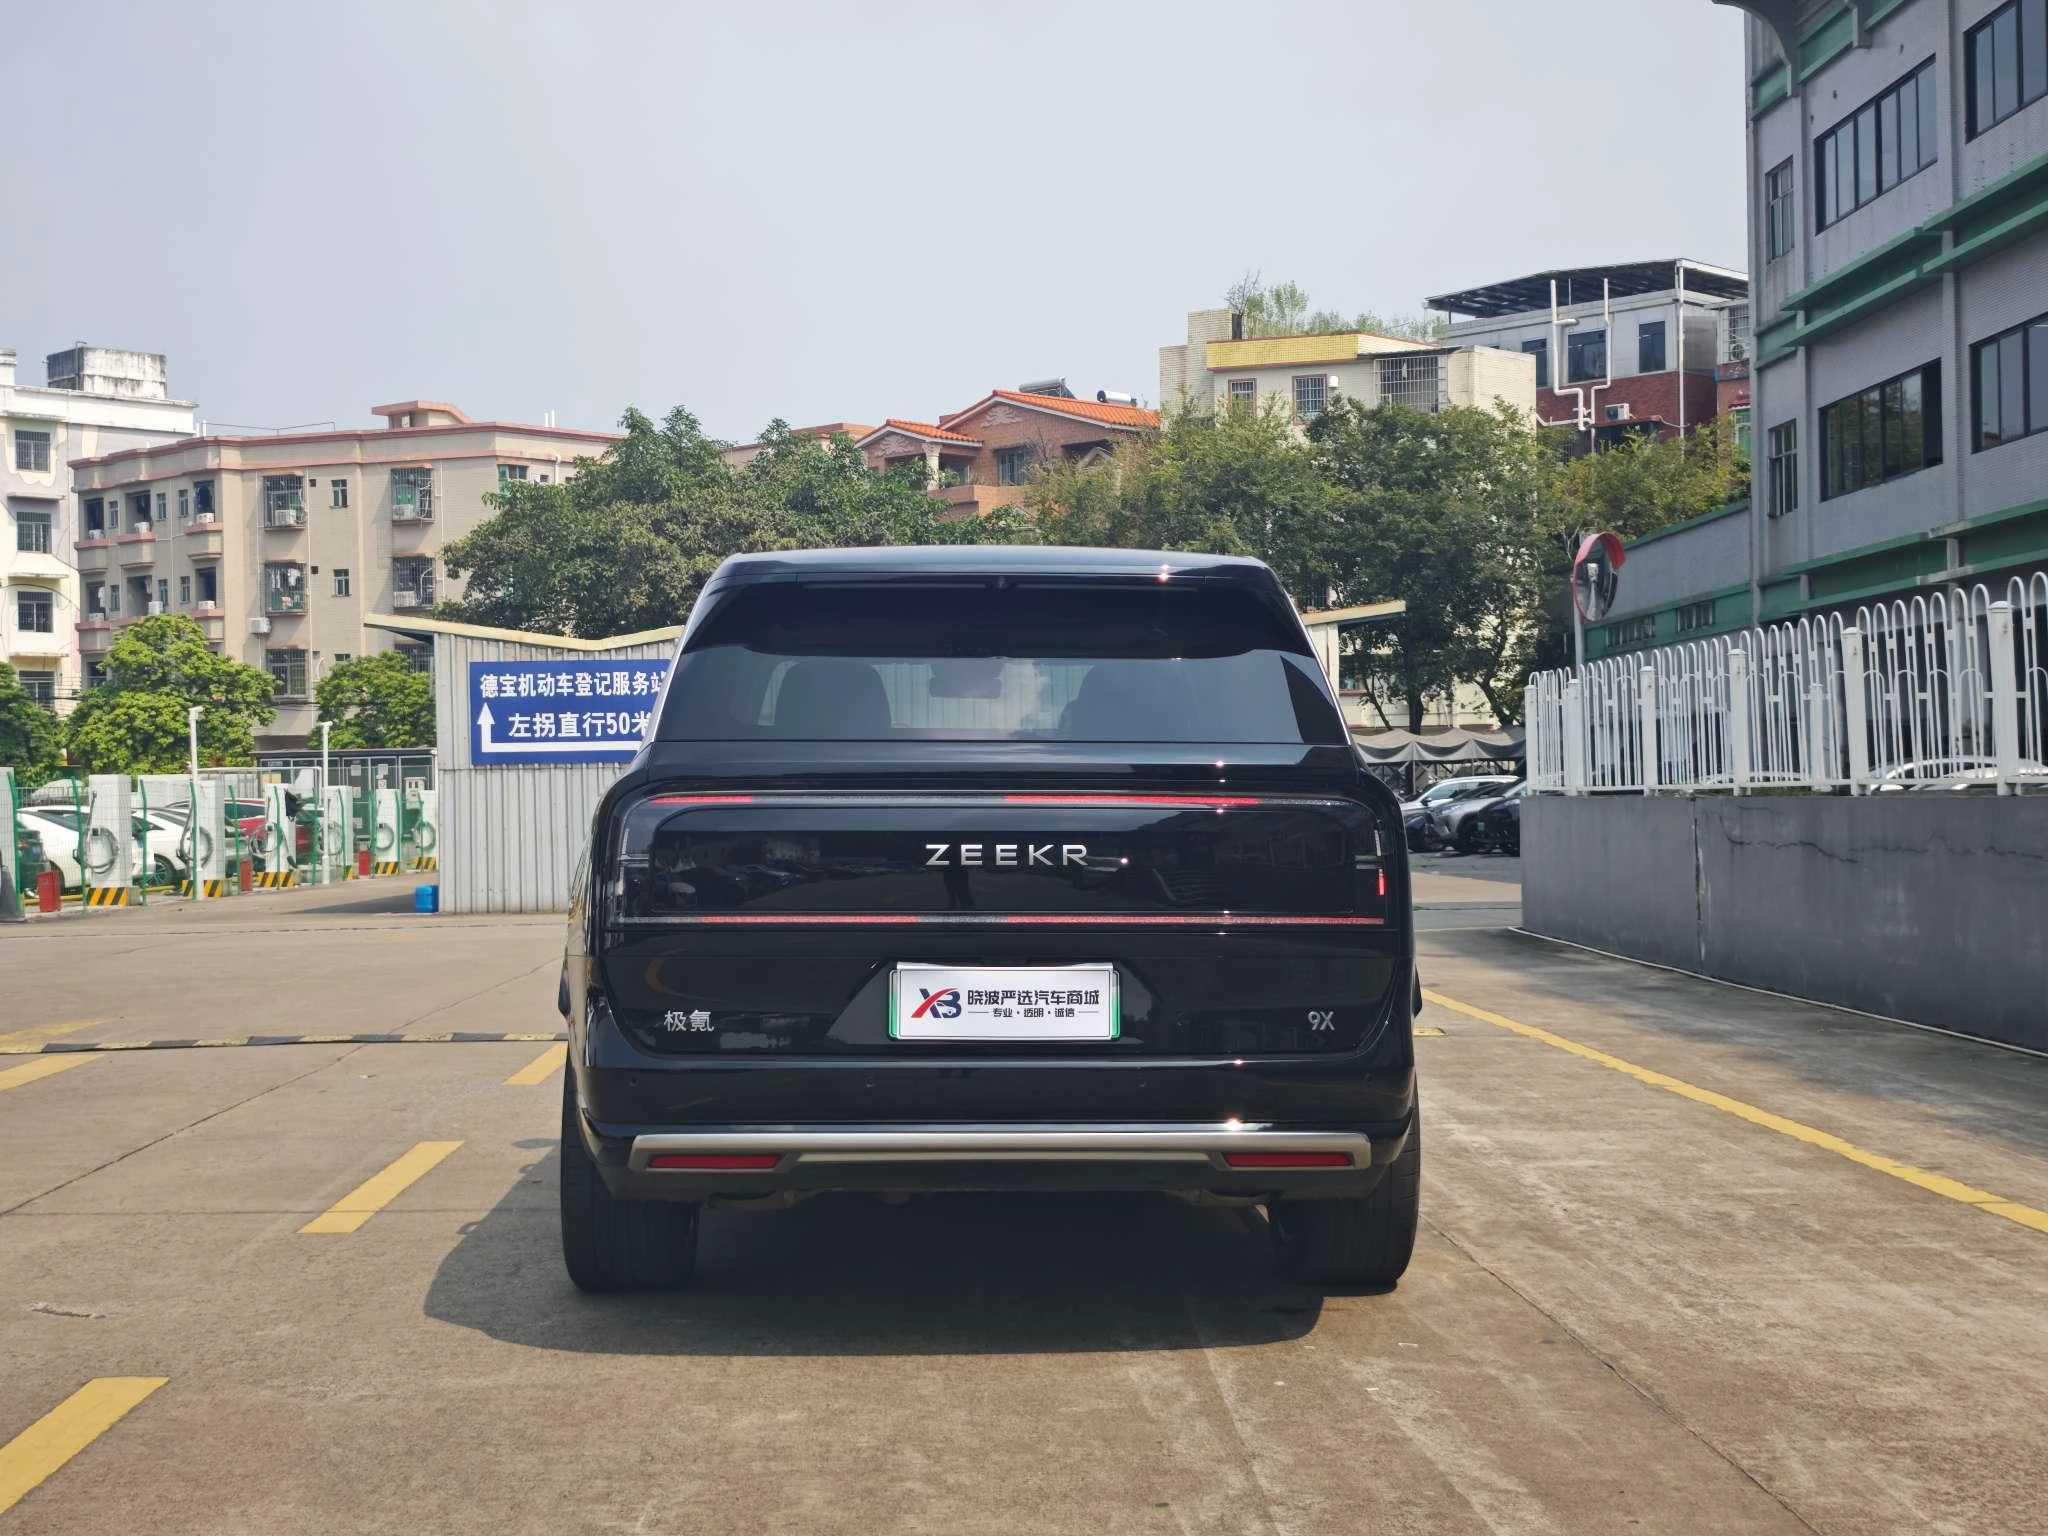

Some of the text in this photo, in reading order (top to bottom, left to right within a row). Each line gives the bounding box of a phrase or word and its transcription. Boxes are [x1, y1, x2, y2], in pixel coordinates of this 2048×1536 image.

[508, 711, 651, 738] 左拐直行50米
[925, 844, 1088, 866] ZEEKR
[967, 989, 1100, 1006] 晓波严选汽车商城
[663, 1009, 715, 1032] 极氪
[1308, 1010, 1335, 1031] 9X
